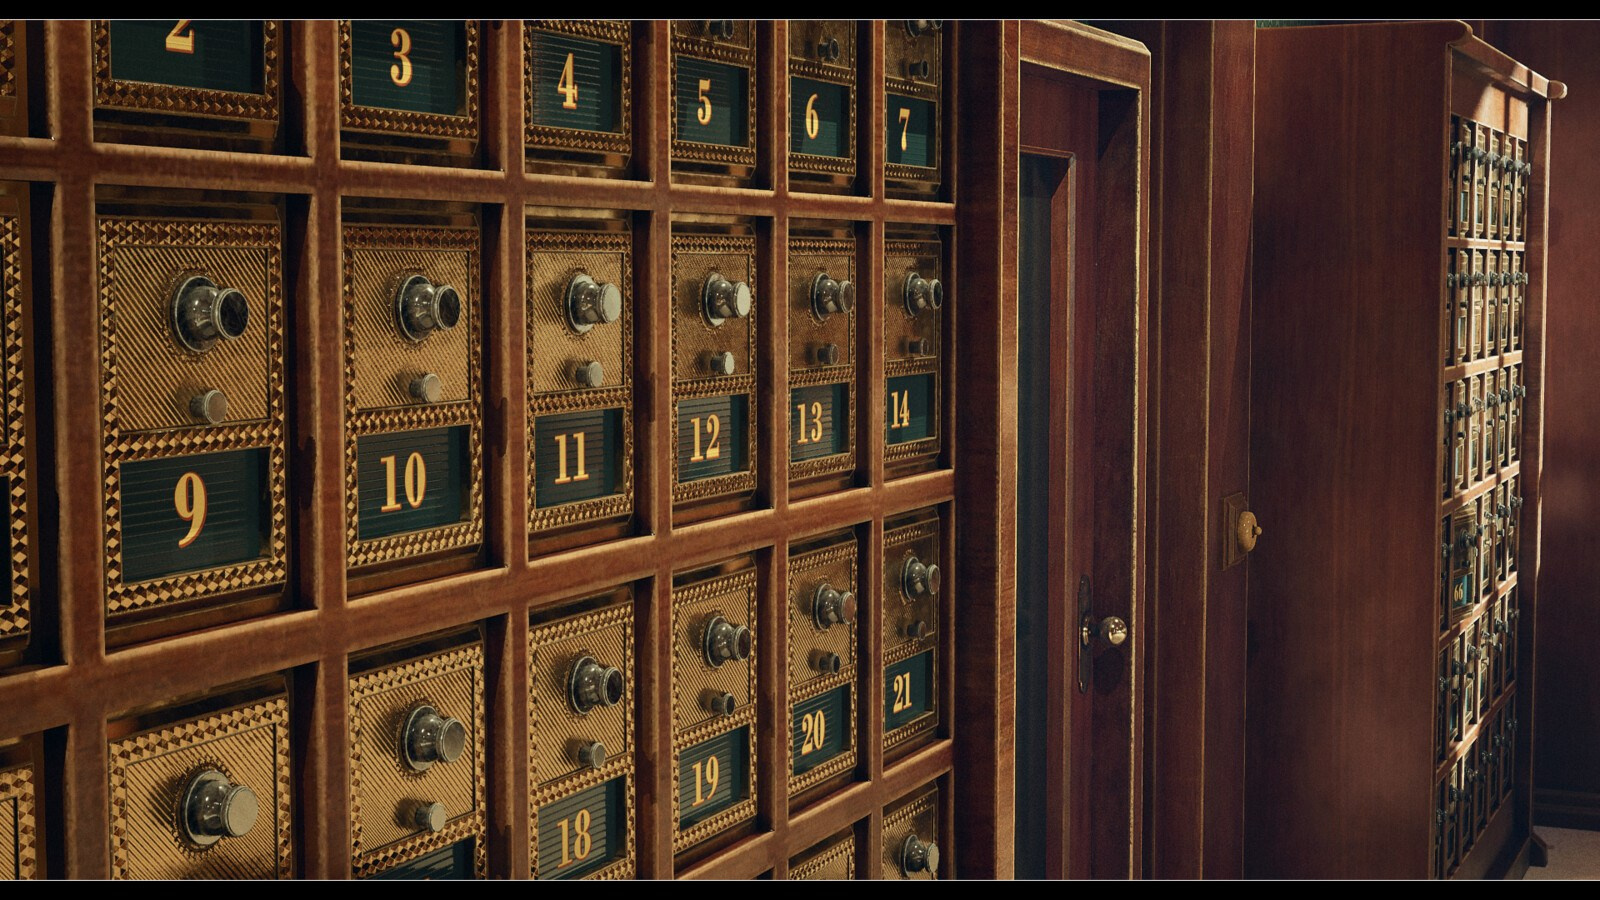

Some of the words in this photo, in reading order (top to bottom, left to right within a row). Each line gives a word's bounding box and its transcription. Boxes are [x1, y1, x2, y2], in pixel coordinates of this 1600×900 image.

[391, 28, 412, 86] 3
[558, 53, 578, 109] 4
[698, 80, 712, 125] 5
[806, 94, 818, 139] 6
[900, 108, 910, 150] 7
[797, 402, 823, 445] 13
[891, 390, 909, 429] 14
[555, 432, 589, 484] 11
[690, 413, 720, 462] 12
[380, 451, 426, 512] 10
[174, 472, 207, 548] 9
[893, 673, 912, 713] 21
[802, 710, 825, 755] 20
[692, 755, 718, 807] 19
[557, 809, 591, 869] 18
